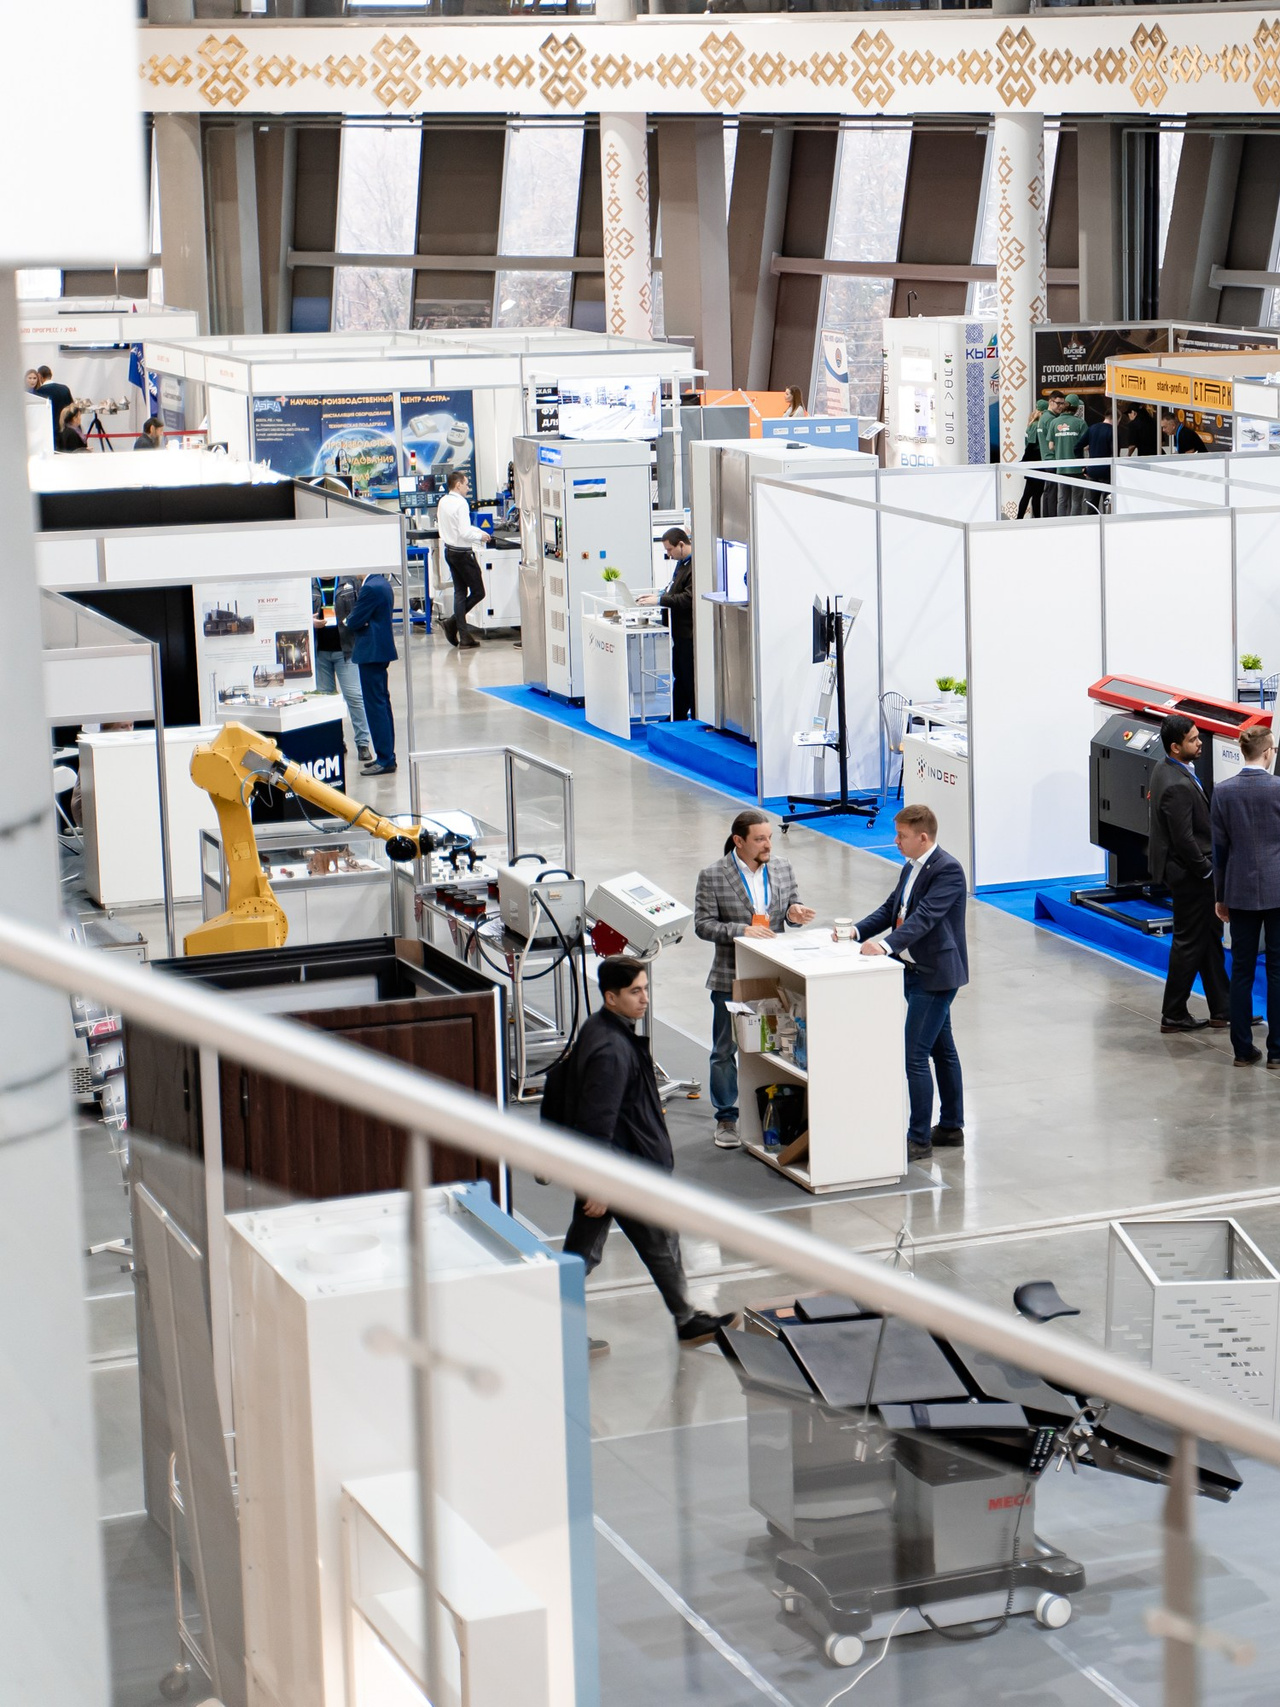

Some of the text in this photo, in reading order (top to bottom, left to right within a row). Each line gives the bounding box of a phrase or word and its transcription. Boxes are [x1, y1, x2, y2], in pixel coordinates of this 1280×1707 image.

[1042, 364, 1106, 372] ГОТОВОЕ ПИТАНИЕ
[1048, 374, 1106, 382] РЕТОРТ-ПАКЕТАХ
[1121, 374, 1146, 390] СТАРК
[1156, 381, 1188, 395] stark-profi.ru
[1194, 382, 1232, 406] СТАРК
[401, 396, 422, 404] ЦЕНТР
[422, 395, 450, 403] «АСТРА»
[326, 438, 392, 450] ПРОИЗВОДСТВО
[1222, 750, 1240, 761] АПП-15
[928, 766, 956, 786] INDEC
